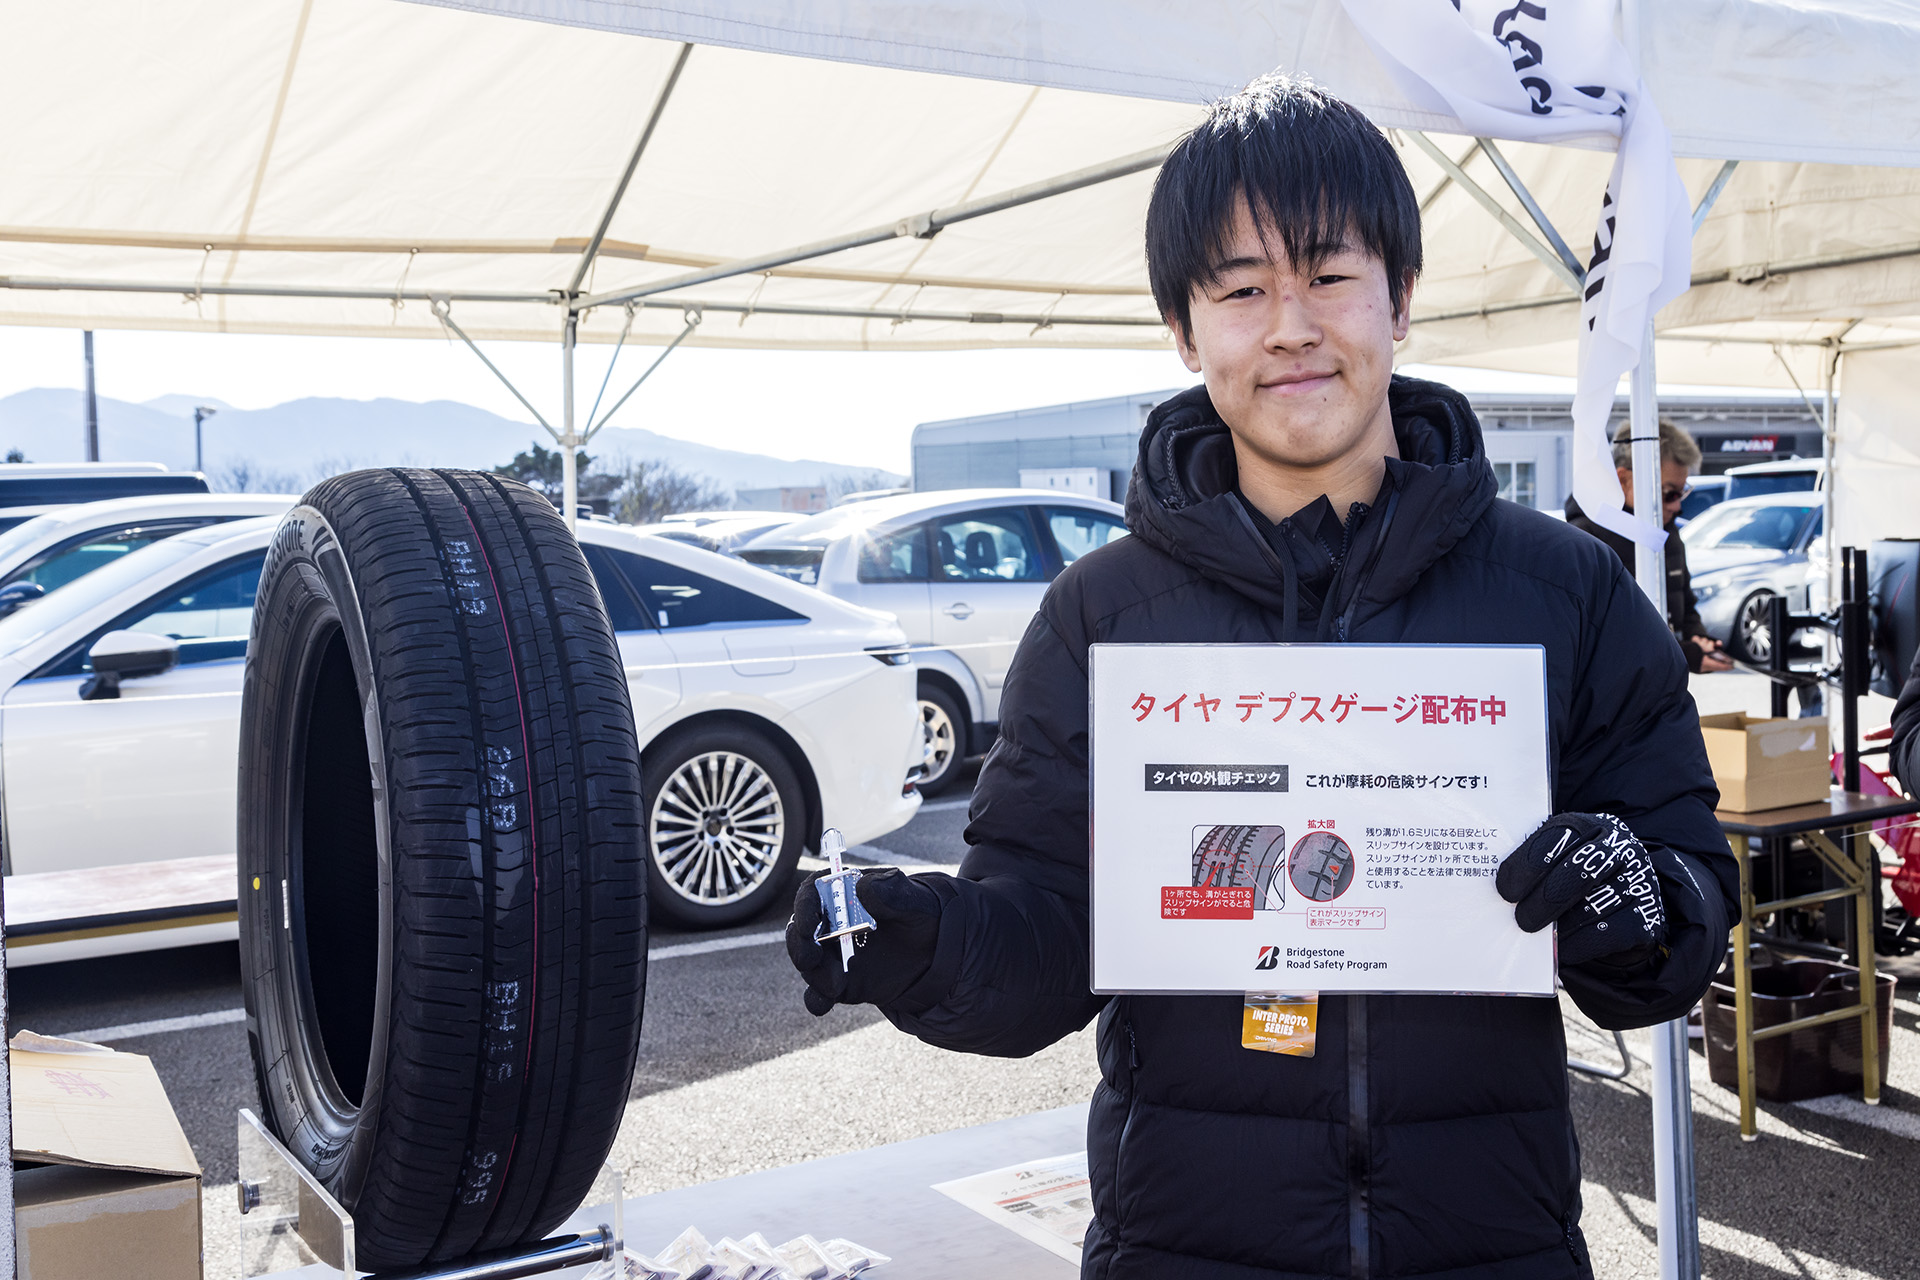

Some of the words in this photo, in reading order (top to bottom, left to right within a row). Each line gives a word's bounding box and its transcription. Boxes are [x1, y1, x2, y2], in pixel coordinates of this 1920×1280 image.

[1720, 439, 1775, 453] ADVAN
[1131, 692, 1222, 723] タイヤ
[1235, 691, 1507, 725] デプスゲージ配布中
[1152, 770, 1282, 786] タイヤの外観チェック
[1307, 819, 1336, 829] 拡大図
[1365, 827, 1498, 838] 残り溝が1.6ミリになる目安として
[1366, 841, 1489, 851] スリップサインを設けています。
[1604, 829, 1662, 930] Mechanix
[1366, 880, 1404, 890] ています。
[1164, 899, 1251, 908] スリップサインがでると危
[1163, 908, 1187, 916] 険です
[1310, 909, 1384, 918] これがスリップサイン
[1310, 918, 1361, 927] 表示マークです
[1286, 947, 1345, 957] Bridgestone
[1286, 960, 1311, 969] Road
[1313, 960, 1344, 971] Safety
[1346, 960, 1388, 971] Program
[1252, 1010, 1278, 1023] INTER
[1278, 1013, 1308, 1027] PROTO
[1264, 1022, 1294, 1036] SERIES
